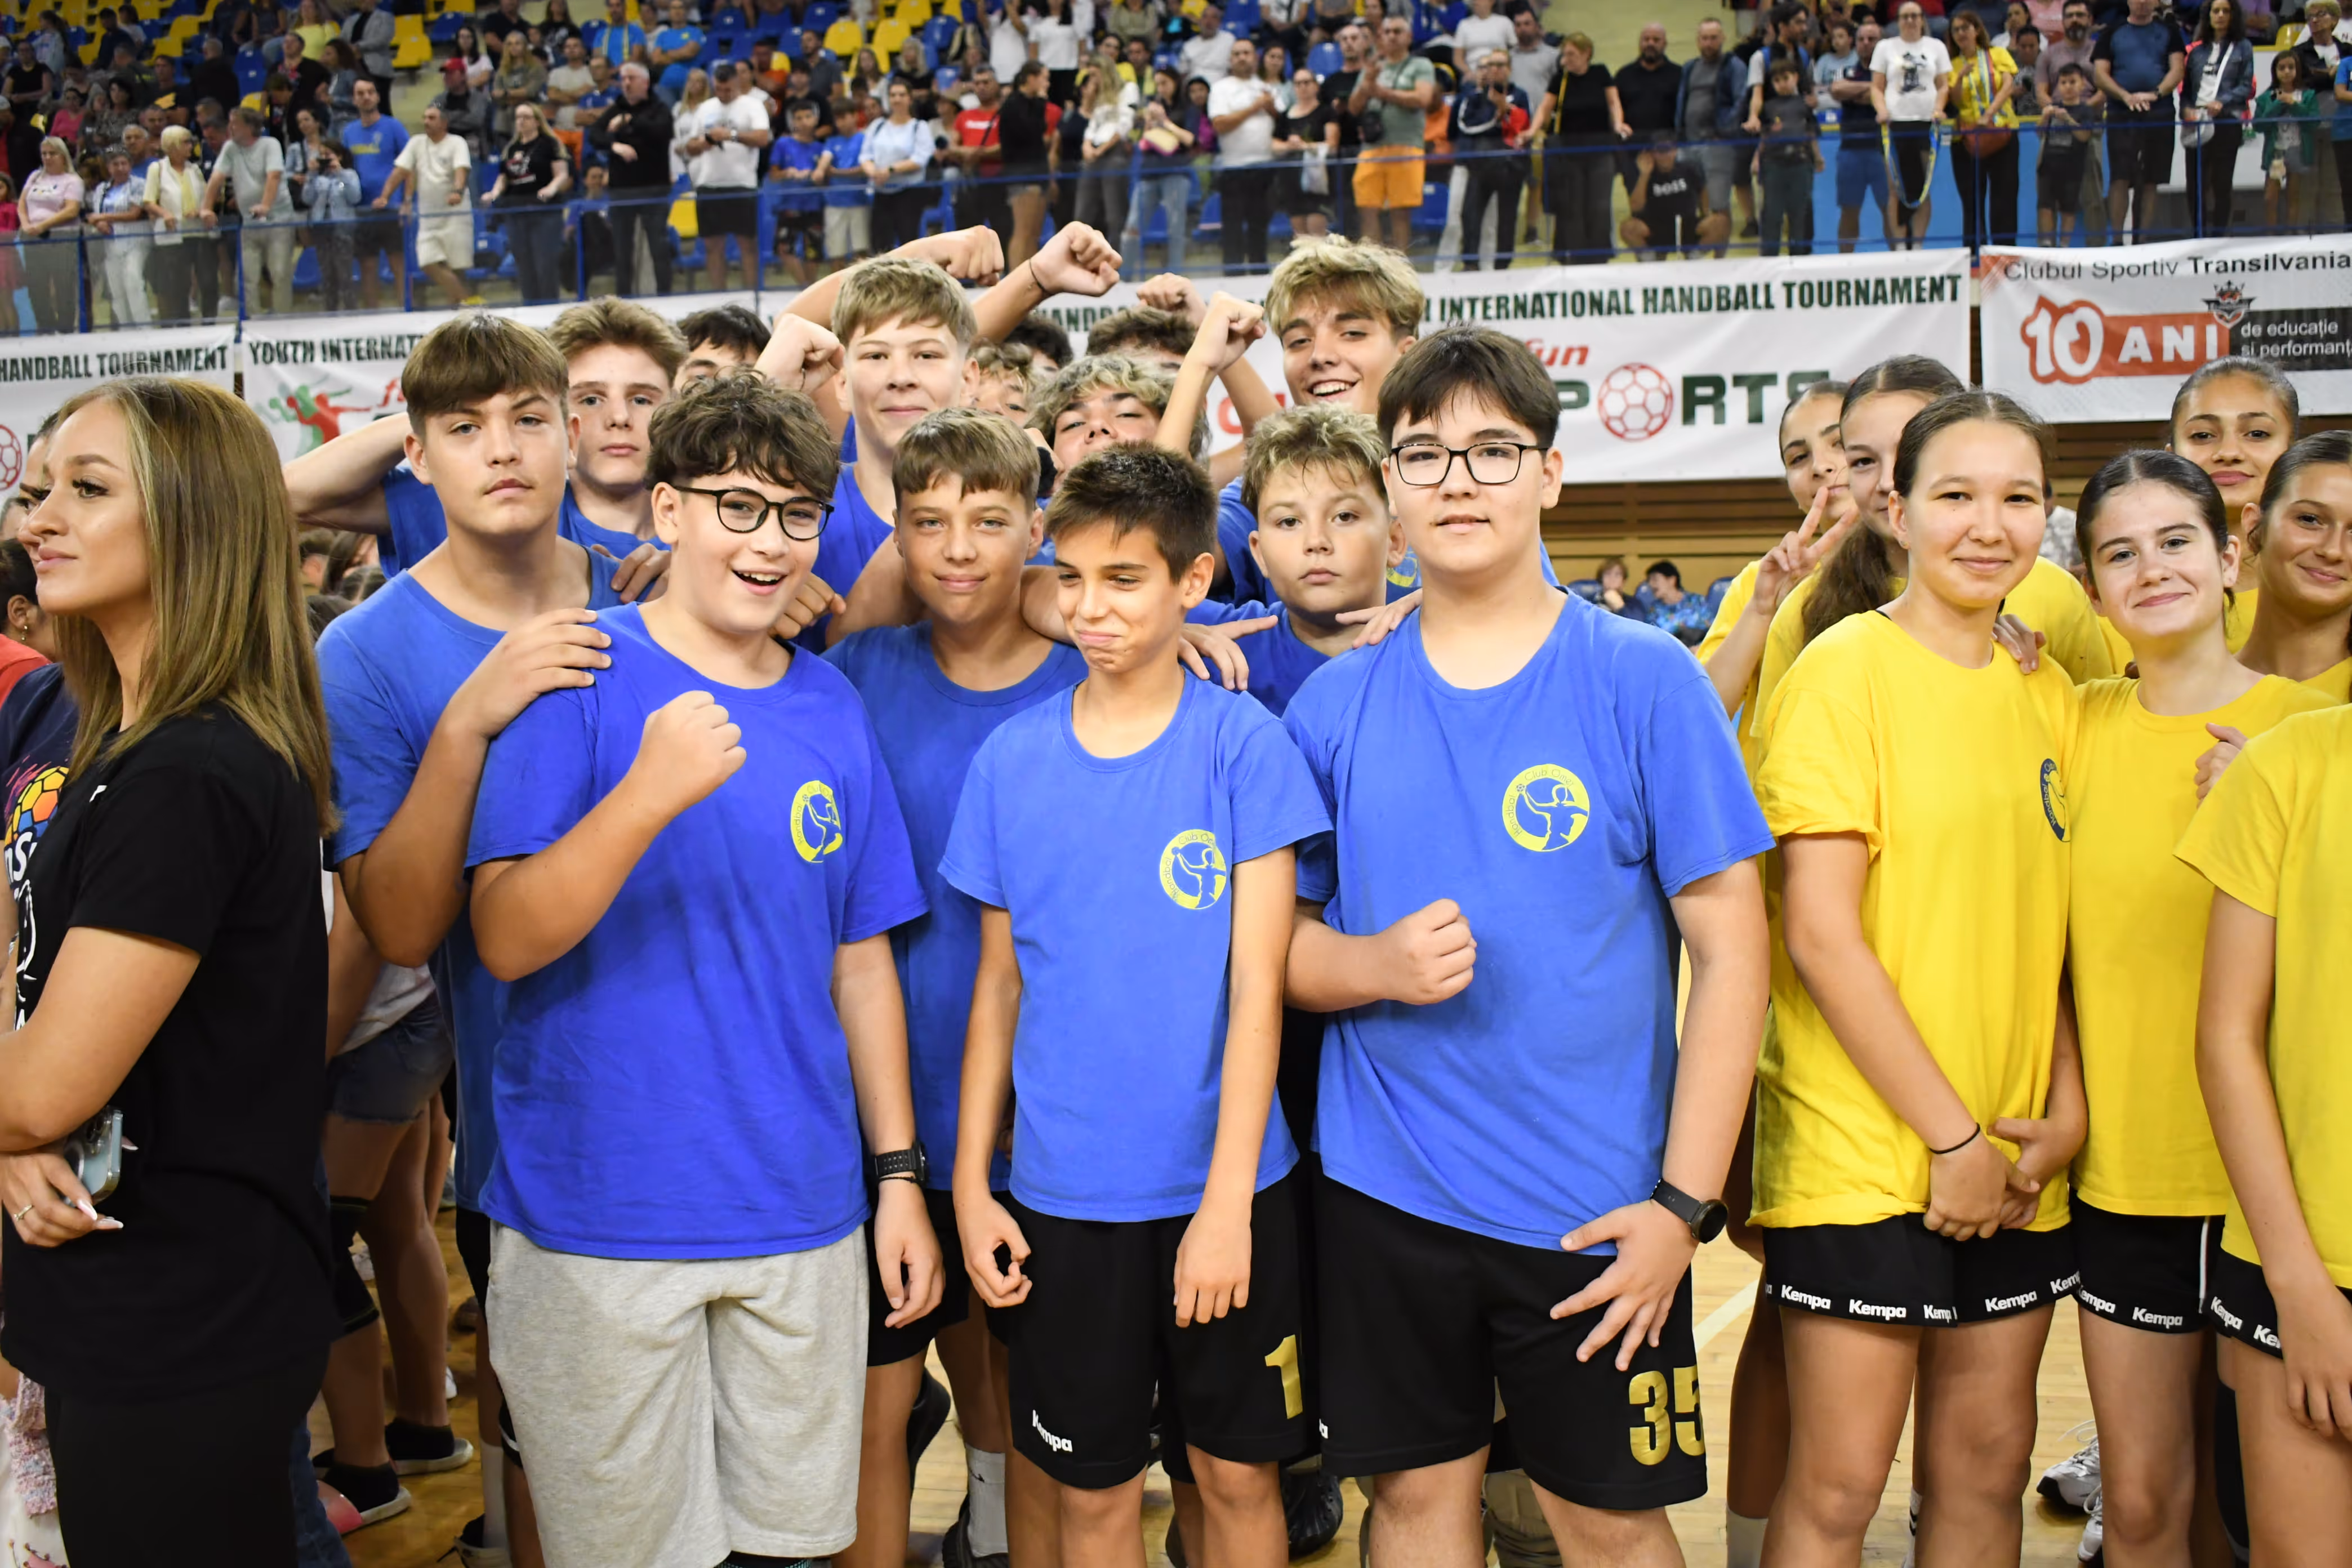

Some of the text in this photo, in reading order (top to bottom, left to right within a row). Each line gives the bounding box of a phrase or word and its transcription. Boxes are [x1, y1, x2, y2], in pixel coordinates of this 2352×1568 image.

[2003, 251, 2351, 283] Clubul Sportiv Transilvania
[1438, 288, 1636, 321] INTERNATIONAL
[1643, 282, 1775, 314] HANDBALL
[1782, 274, 1962, 309] TOURNAMENT
[2025, 306, 2218, 377] 10 ANI
[2240, 321, 2262, 338] de
[0, 345, 228, 382] HANDBALL TOURNAMENT
[249, 333, 424, 365] YOUTH INTERNAT
[1505, 794, 1522, 838] Handbal
[1524, 768, 1547, 781] Club
[2042, 783, 2056, 826] Handbal
[1163, 857, 1181, 898] Handbal
[1179, 834, 1198, 845] Club
[1781, 1284, 1831, 1310] Kempa
[1849, 1299, 1906, 1321] Kempa
[1923, 1304, 1952, 1324] Kemp
[1985, 1290, 2037, 1312] Kempa
[2132, 1307, 2183, 1329] Kempa
[1264, 1334, 1303, 1420] 1
[1629, 1364, 1706, 1465] 35
